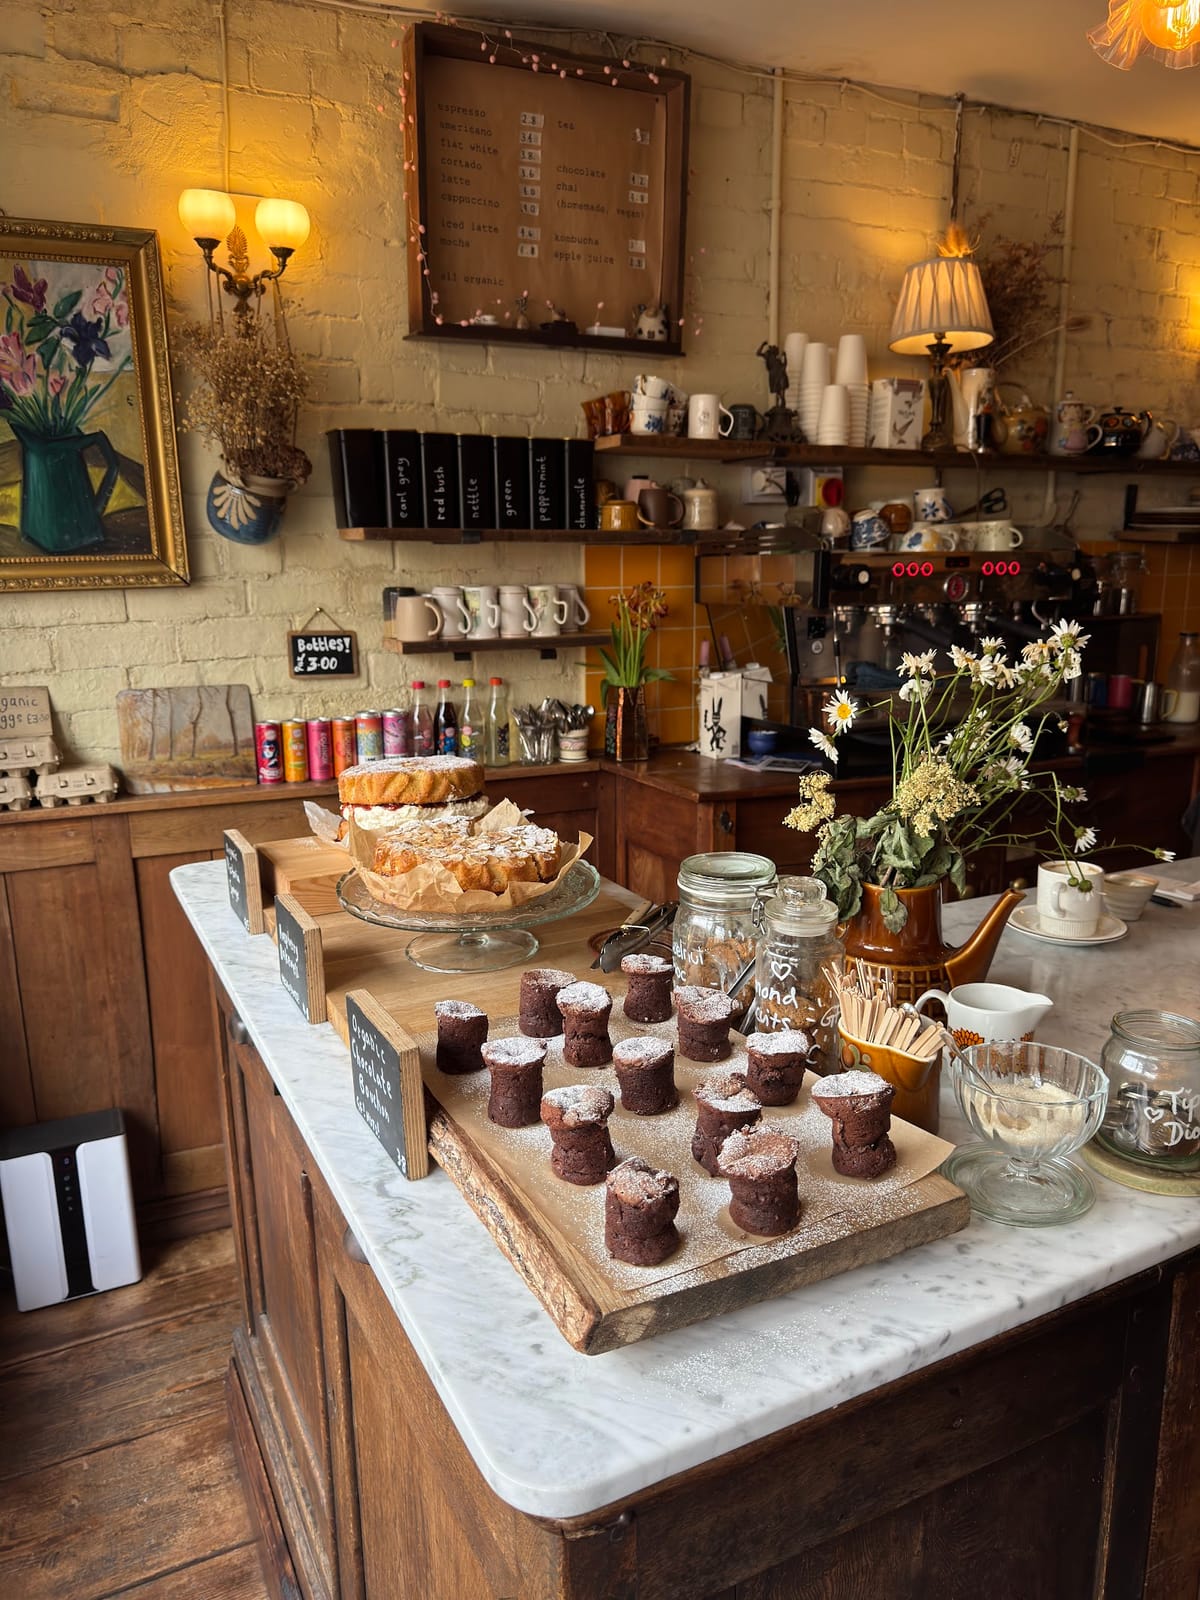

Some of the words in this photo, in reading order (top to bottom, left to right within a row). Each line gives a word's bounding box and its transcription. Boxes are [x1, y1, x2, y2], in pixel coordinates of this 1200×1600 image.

[437, 103, 486, 118] espresso
[557, 120, 576, 130] tea
[440, 138, 464, 151] flat
[470, 143, 498, 156] white
[440, 157, 482, 170] cortado
[556, 164, 606, 179] chocolate
[441, 172, 471, 186] latte
[556, 182, 577, 192] chai
[440, 193, 500, 209] cappuccino
[441, 217, 464, 230] iced
[472, 221, 499, 234] latte
[440, 238, 470, 248] mocha
[554, 250, 581, 262] apple
[588, 254, 615, 265] juice
[440, 271, 456, 282] all
[463, 275, 505, 287] organic
[397, 457, 410, 485] grey
[433, 466, 446, 493] bush
[536, 455, 552, 522] peppermint
[396, 491, 408, 519] earl
[466, 478, 480, 519] nettle
[504, 479, 517, 517] green
[433, 498, 446, 520] red
[296, 636, 351, 654] Bottles!
[351, 1013, 386, 1065] Organic
[351, 1037, 393, 1100] Chocolate
[1159, 1086, 1200, 1123] Tip
